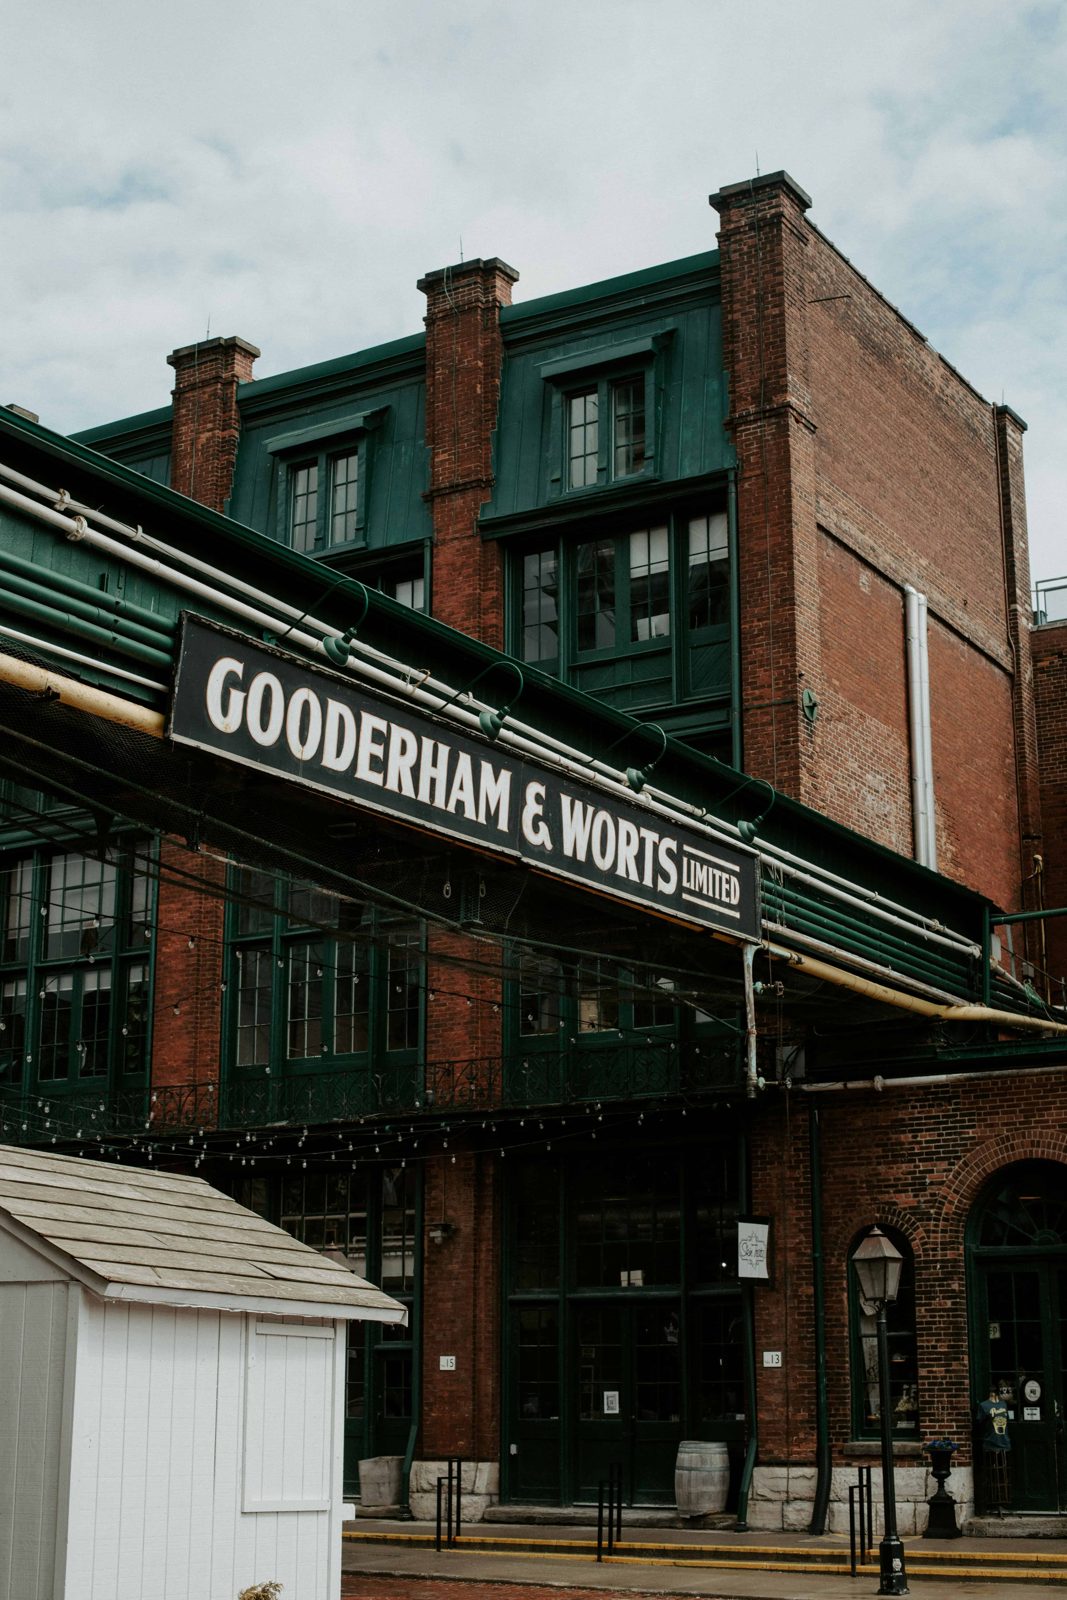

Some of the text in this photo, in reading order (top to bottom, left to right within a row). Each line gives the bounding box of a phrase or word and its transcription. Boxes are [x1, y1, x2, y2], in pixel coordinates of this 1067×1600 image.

[205, 656, 741, 905] GOODERHAM & WORTS LIMITED
[446, 1358, 454, 1368] 15
[771, 1353, 780, 1364] 13
